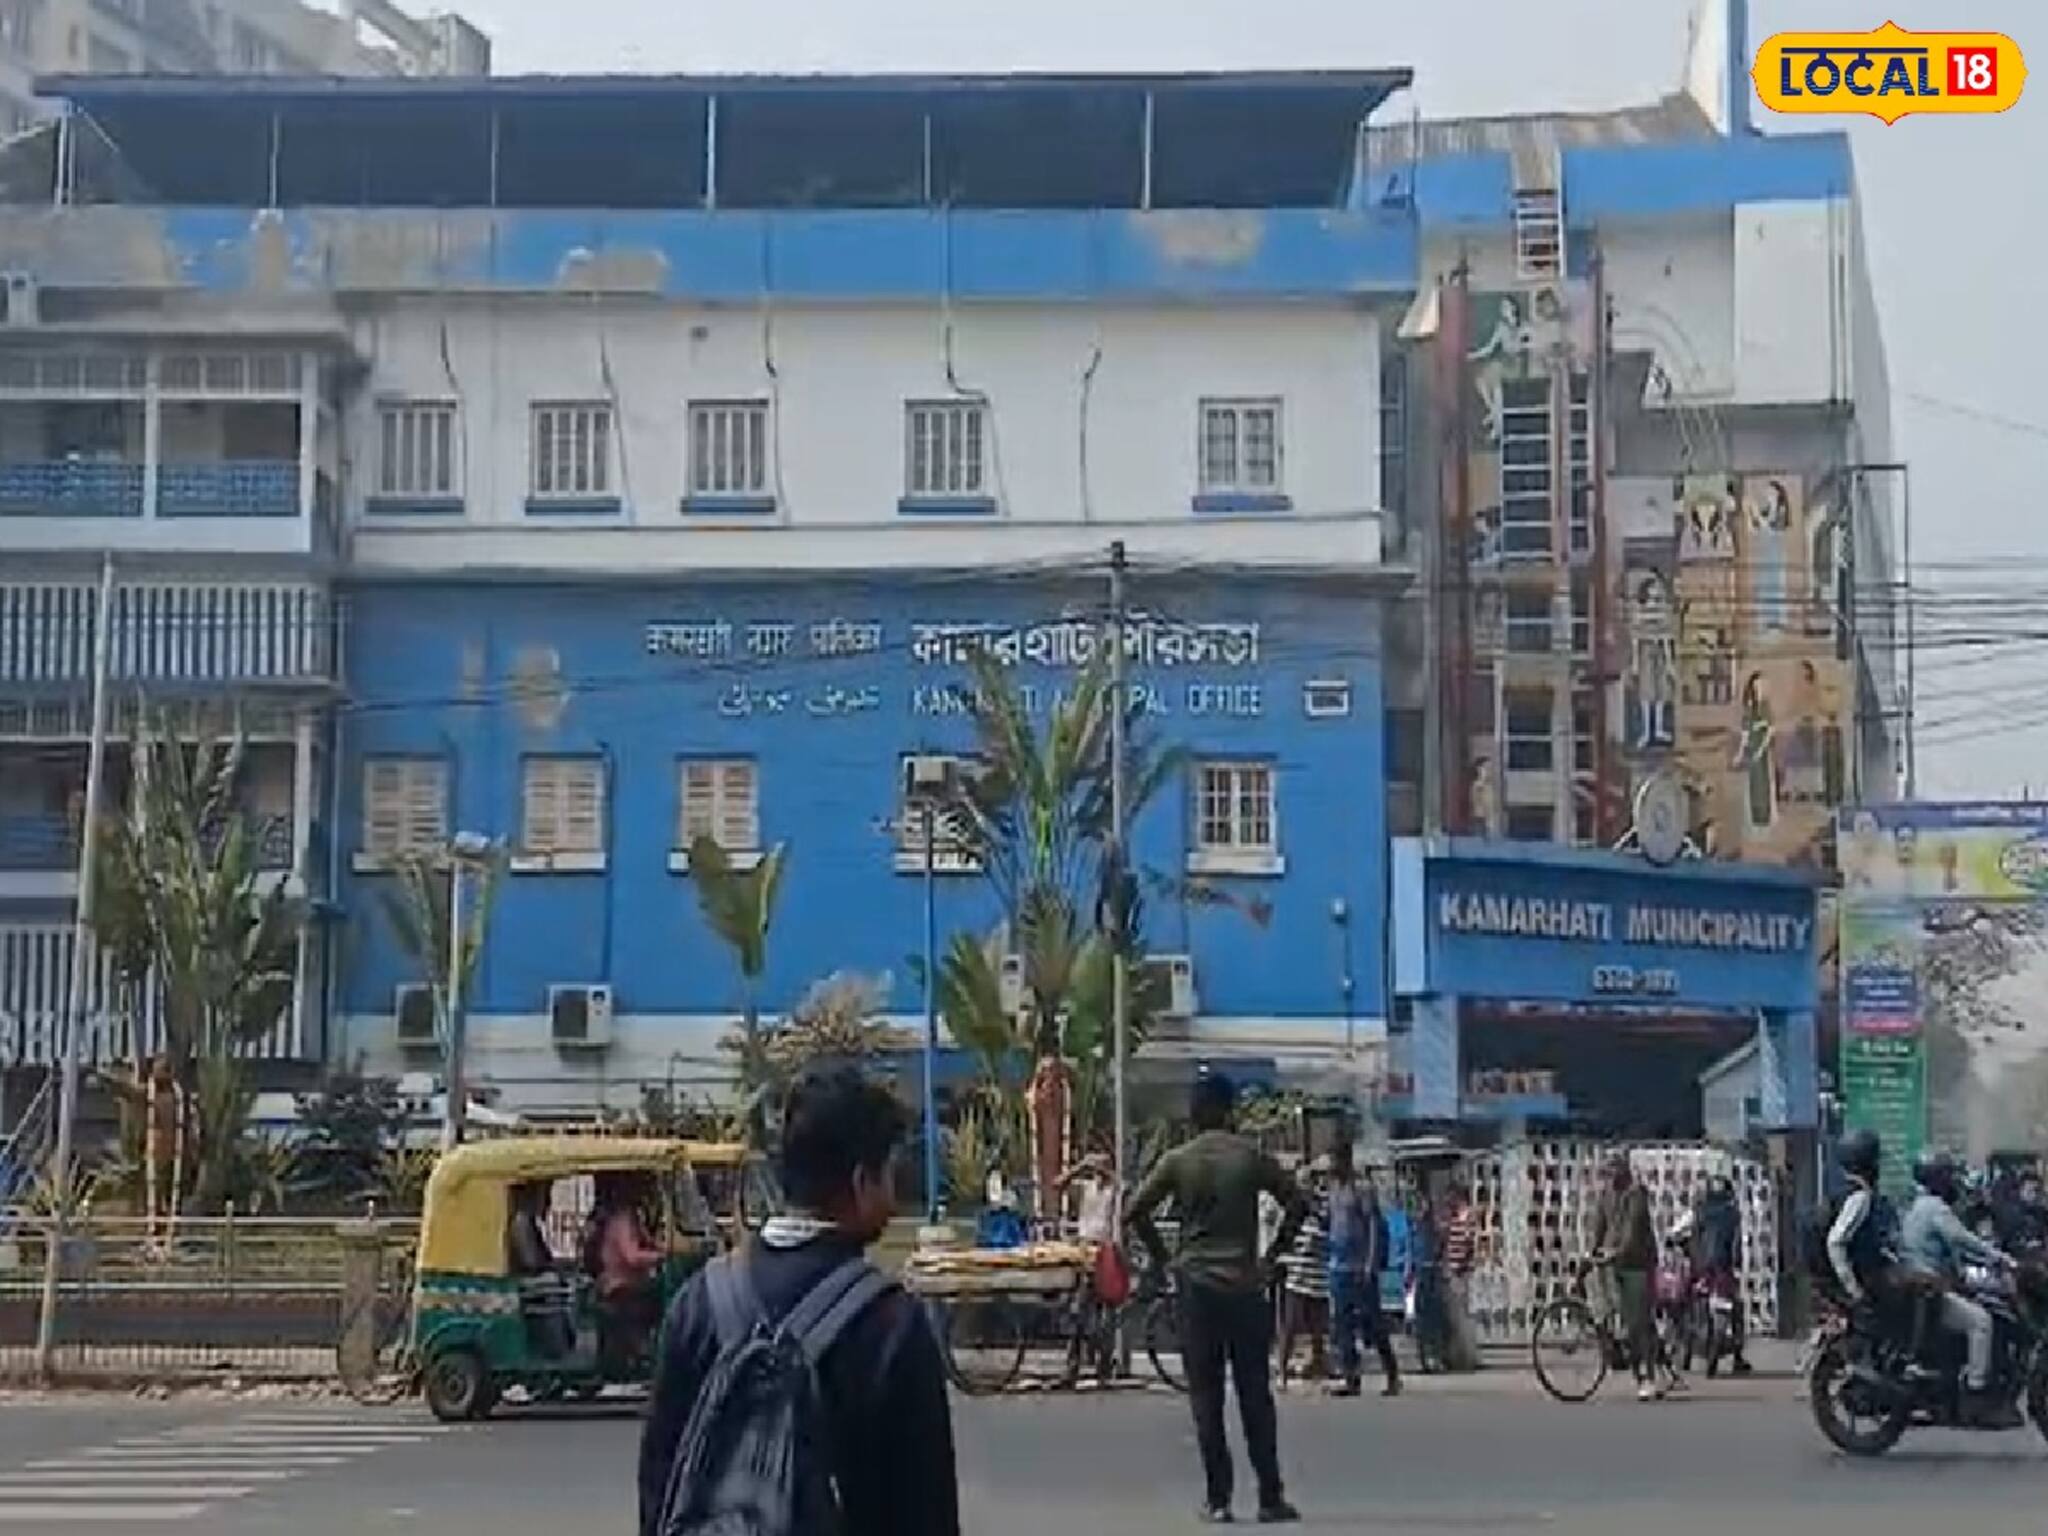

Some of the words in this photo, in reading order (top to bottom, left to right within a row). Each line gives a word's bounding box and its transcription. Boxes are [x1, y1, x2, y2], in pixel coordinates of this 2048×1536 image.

[1188, 684, 1262, 716] OFFICE
[1439, 892, 1613, 941] KAMARHATI
[1628, 904, 1811, 950] MUNICIPALITY
